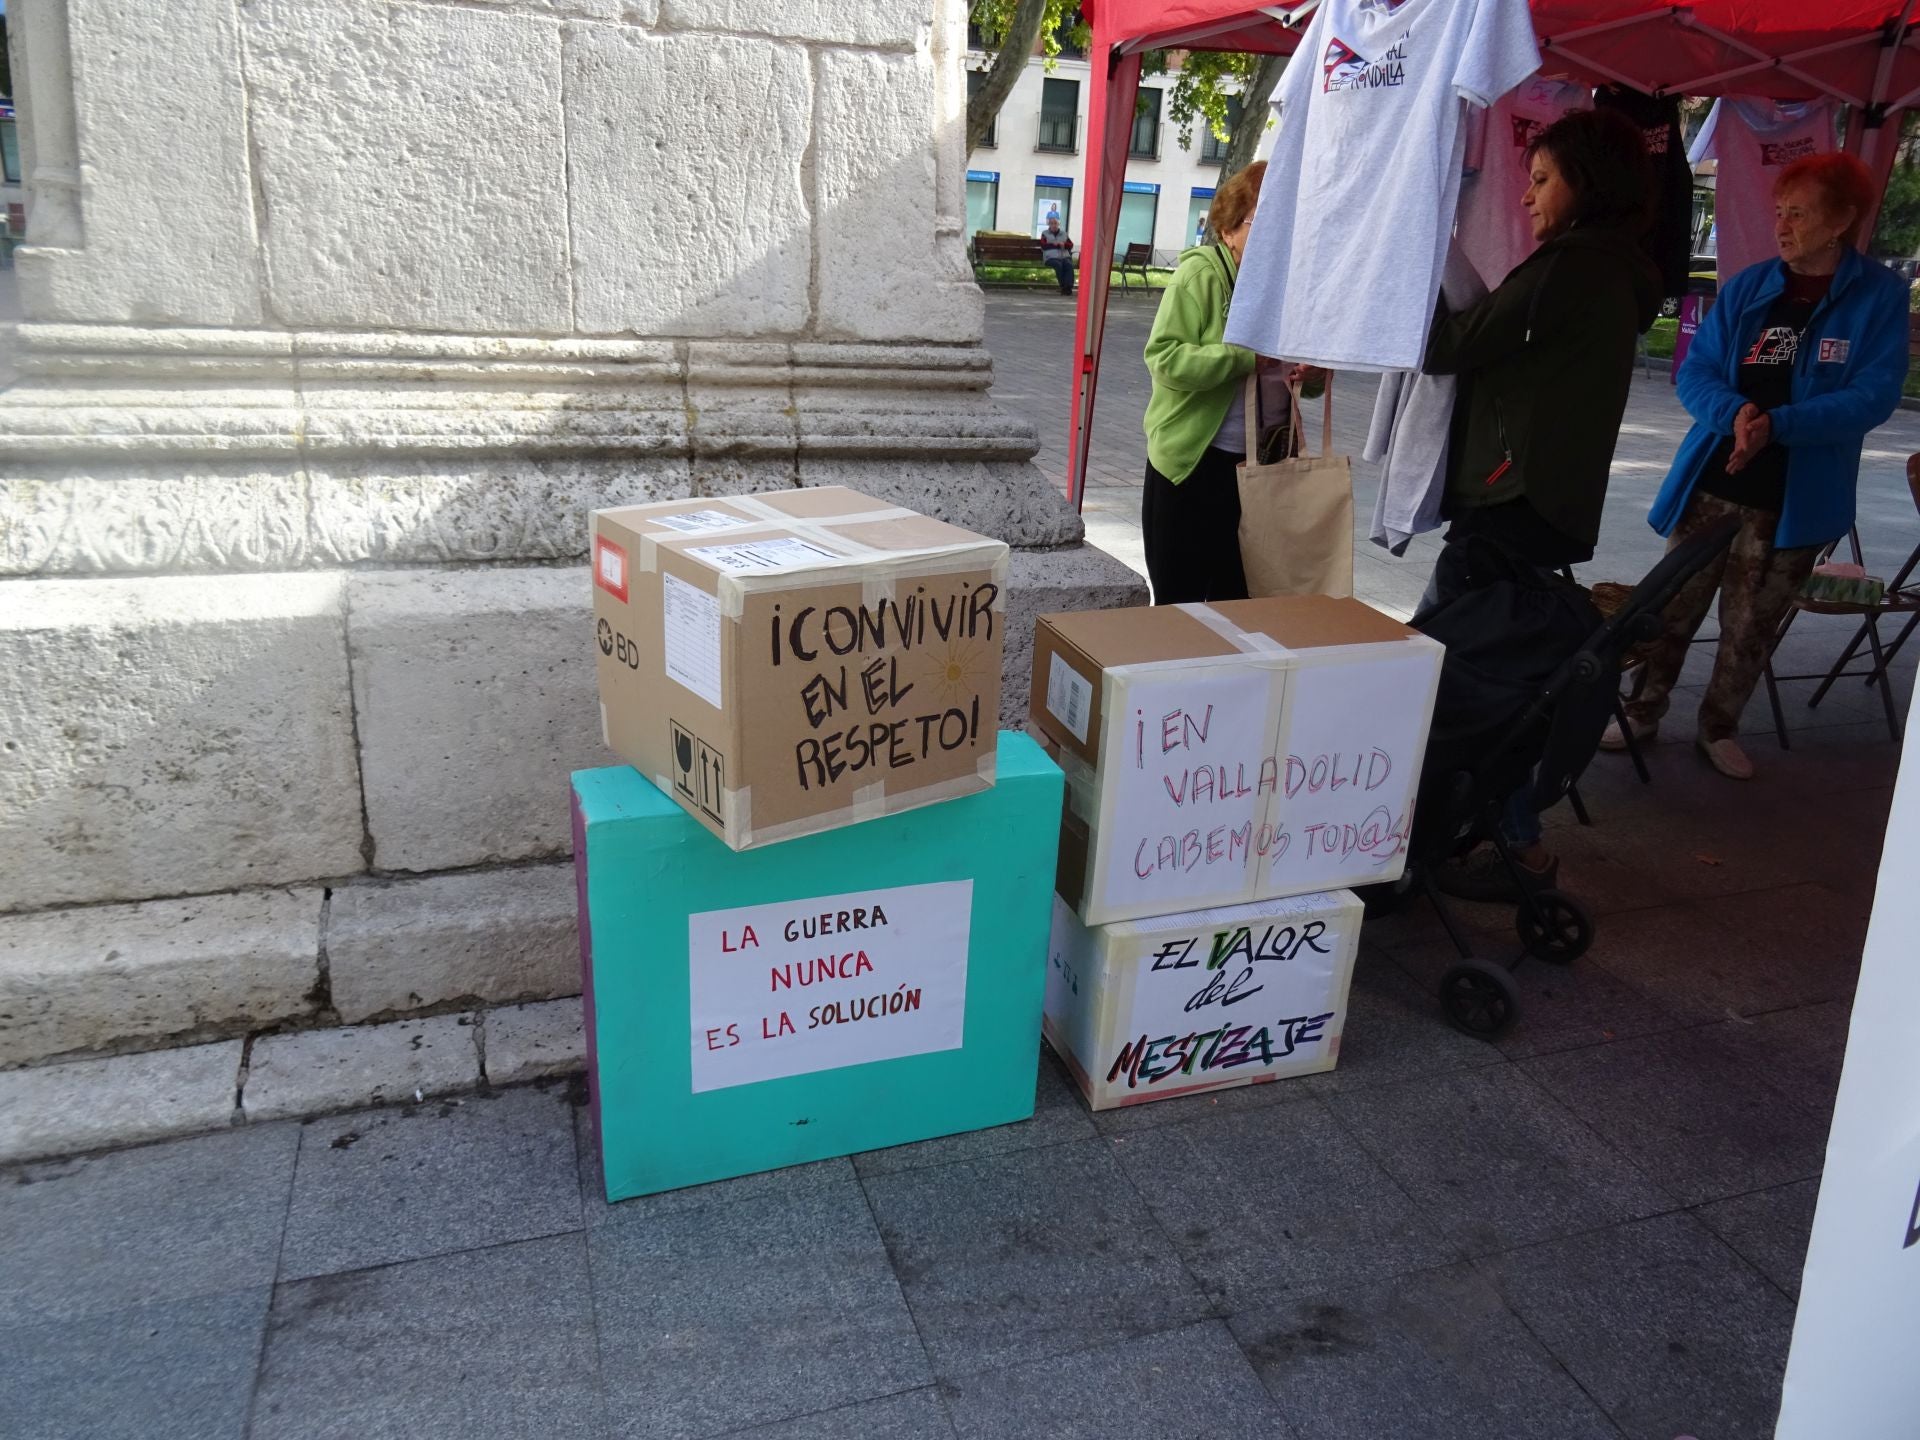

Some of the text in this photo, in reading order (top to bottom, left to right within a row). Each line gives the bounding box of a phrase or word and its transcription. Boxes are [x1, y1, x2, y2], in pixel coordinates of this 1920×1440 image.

[616, 631, 639, 670] BD
[801, 666, 847, 729] EN
[796, 695, 979, 790] RESPETO!
[1164, 746, 1392, 807] VALLADOLID
[1134, 797, 1416, 879] CABEMOS TOD@S!
[722, 905, 888, 952] LA GUERRA
[1151, 920, 1331, 972] EL VALOR
[771, 950, 873, 992] NUNCA
[1184, 966, 1264, 1013] del
[706, 983, 922, 1050] ES LA SOLUCIÓN
